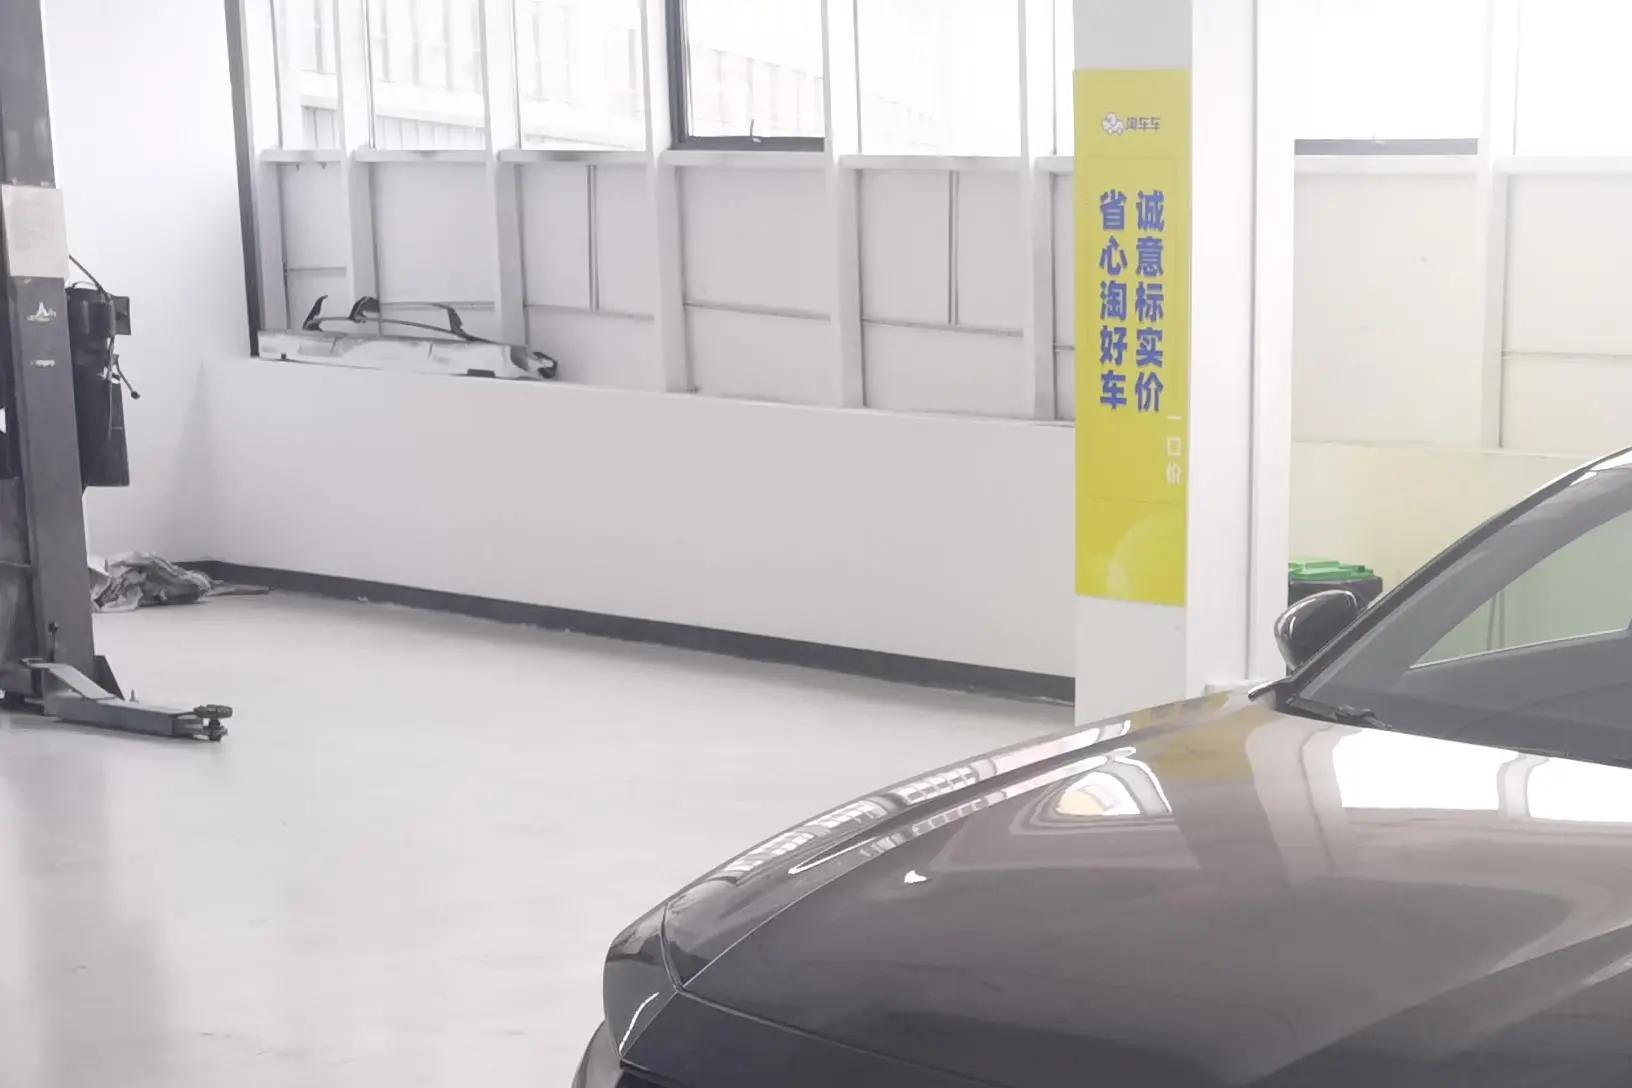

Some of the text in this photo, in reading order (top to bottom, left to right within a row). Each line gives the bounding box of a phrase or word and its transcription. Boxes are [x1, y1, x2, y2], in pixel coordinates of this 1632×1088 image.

[1099, 190, 1129, 411] 省心淘好车
[1134, 190, 1166, 413] 诚意标实价
[1166, 416, 1182, 486] 一口价
